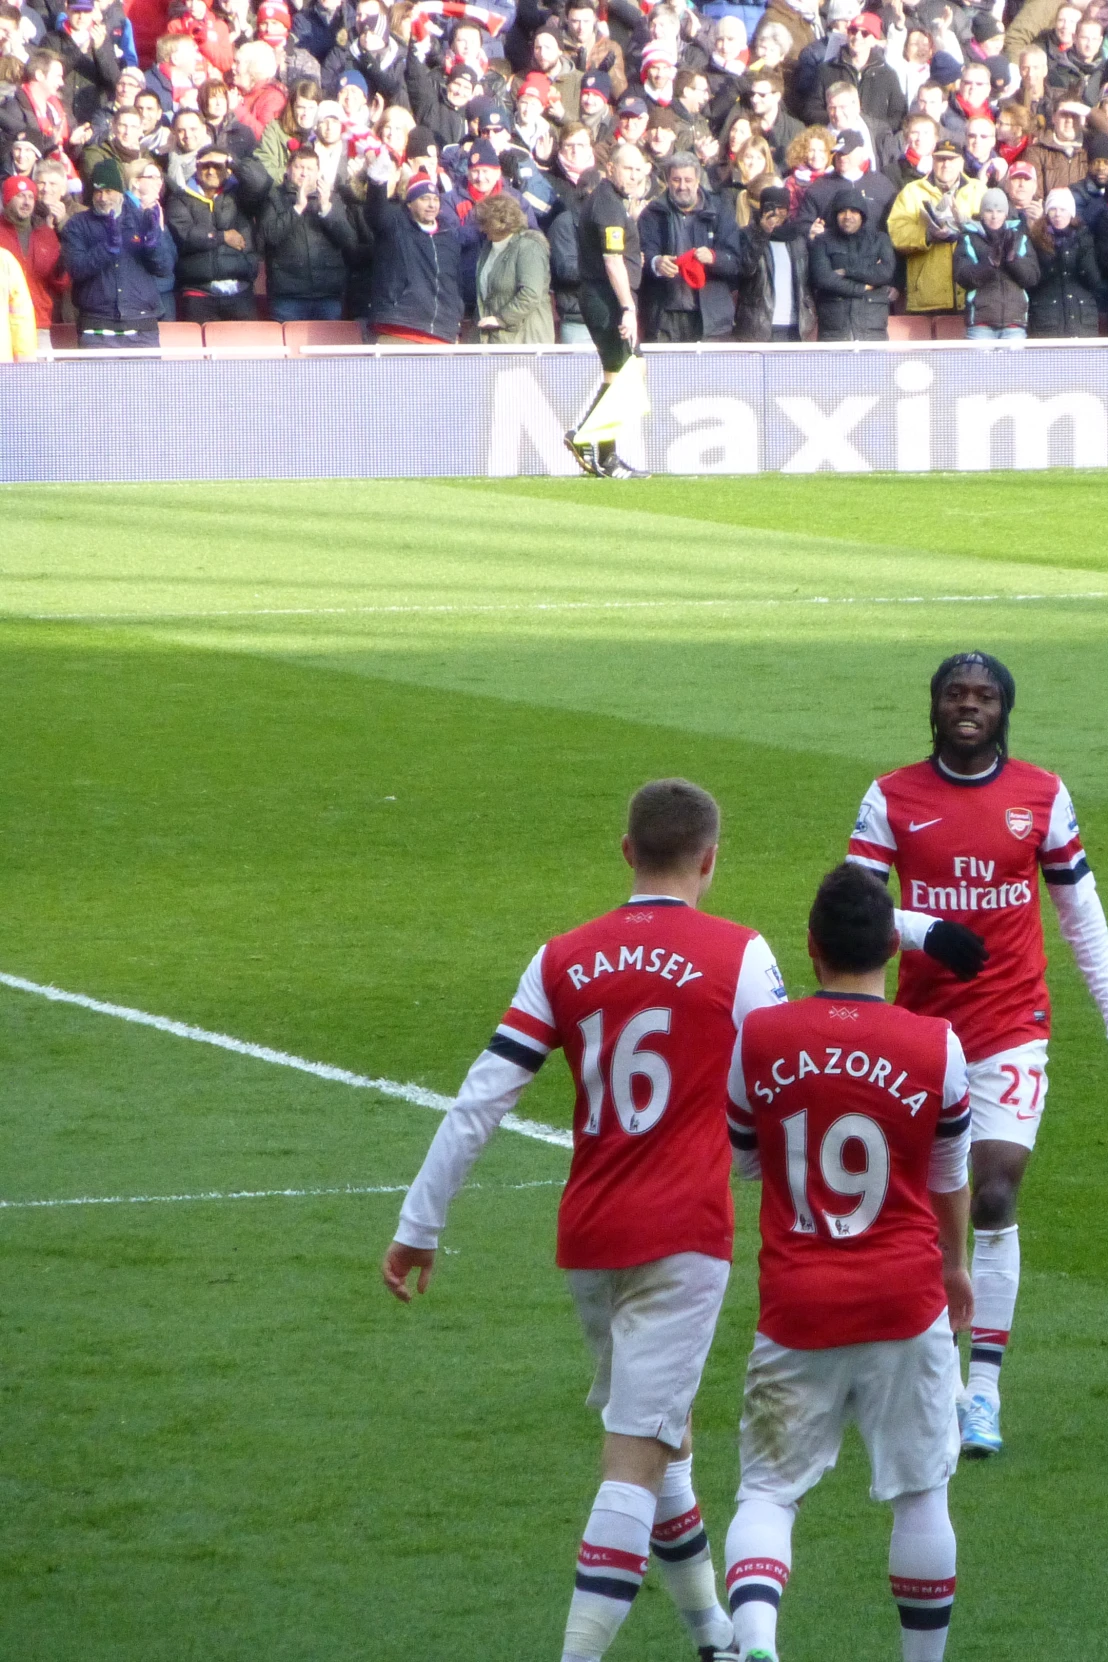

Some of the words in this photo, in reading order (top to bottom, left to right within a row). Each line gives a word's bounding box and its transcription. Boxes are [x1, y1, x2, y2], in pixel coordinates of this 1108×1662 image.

[953, 856, 995, 882] Fly
[910, 876, 1032, 911] Emirates
[566, 945, 704, 992] RAMSEY
[576, 1006, 672, 1135] 16
[754, 1047, 928, 1118] S.CAZORLA
[999, 1063, 1042, 1111] 27
[781, 1108, 890, 1239] 19
